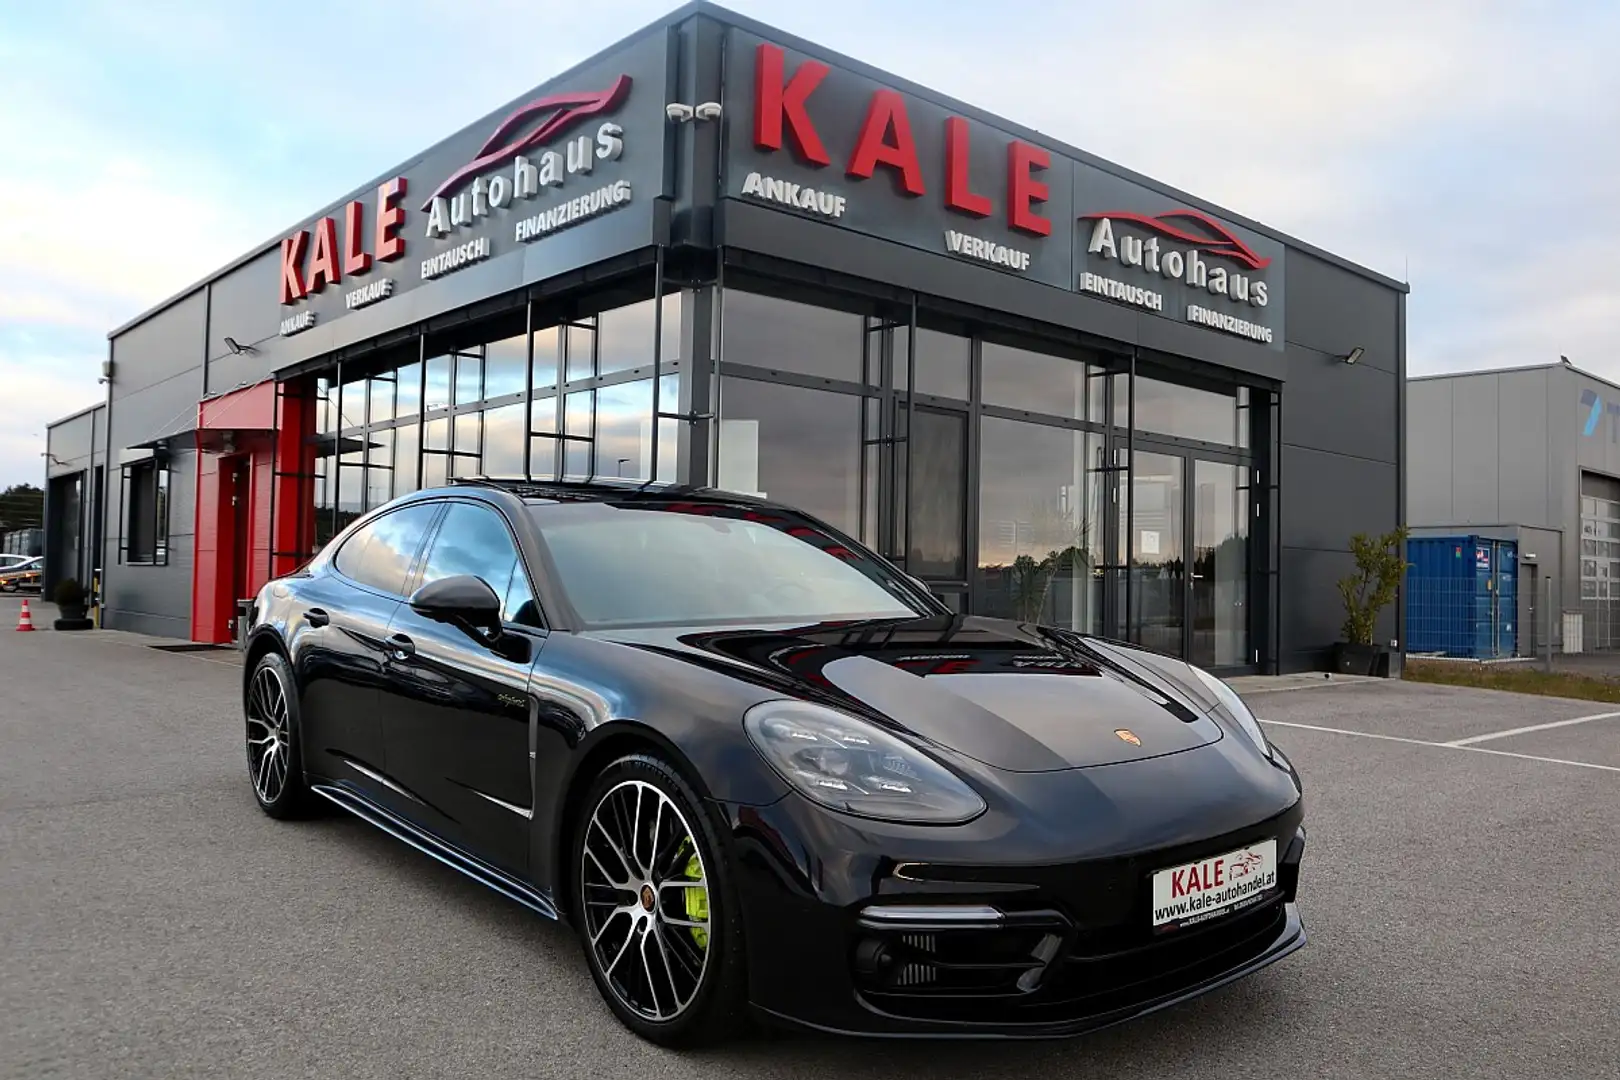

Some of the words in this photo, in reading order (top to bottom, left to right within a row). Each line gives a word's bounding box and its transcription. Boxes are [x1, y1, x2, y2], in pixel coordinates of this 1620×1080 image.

[425, 122, 623, 237] Autohaus
[754, 42, 1051, 236] KALE
[279, 176, 408, 306] KALE
[279, 310, 316, 336] ANKAUF
[345, 278, 394, 309] VERKAUF
[421, 237, 490, 279] EINTAUSCH
[515, 180, 631, 242] FINANZIERUNG
[741, 172, 846, 217] ANKAUF
[944, 229, 1030, 271] VERKAUF
[1080, 272, 1163, 311] EINTAUSCH
[1187, 305, 1272, 343] FINANZIERUNG
[1088, 217, 1268, 307] Autohaus
[1155, 870, 1275, 921] www.kale-autohandel.at
[1172, 860, 1224, 898] KALE
